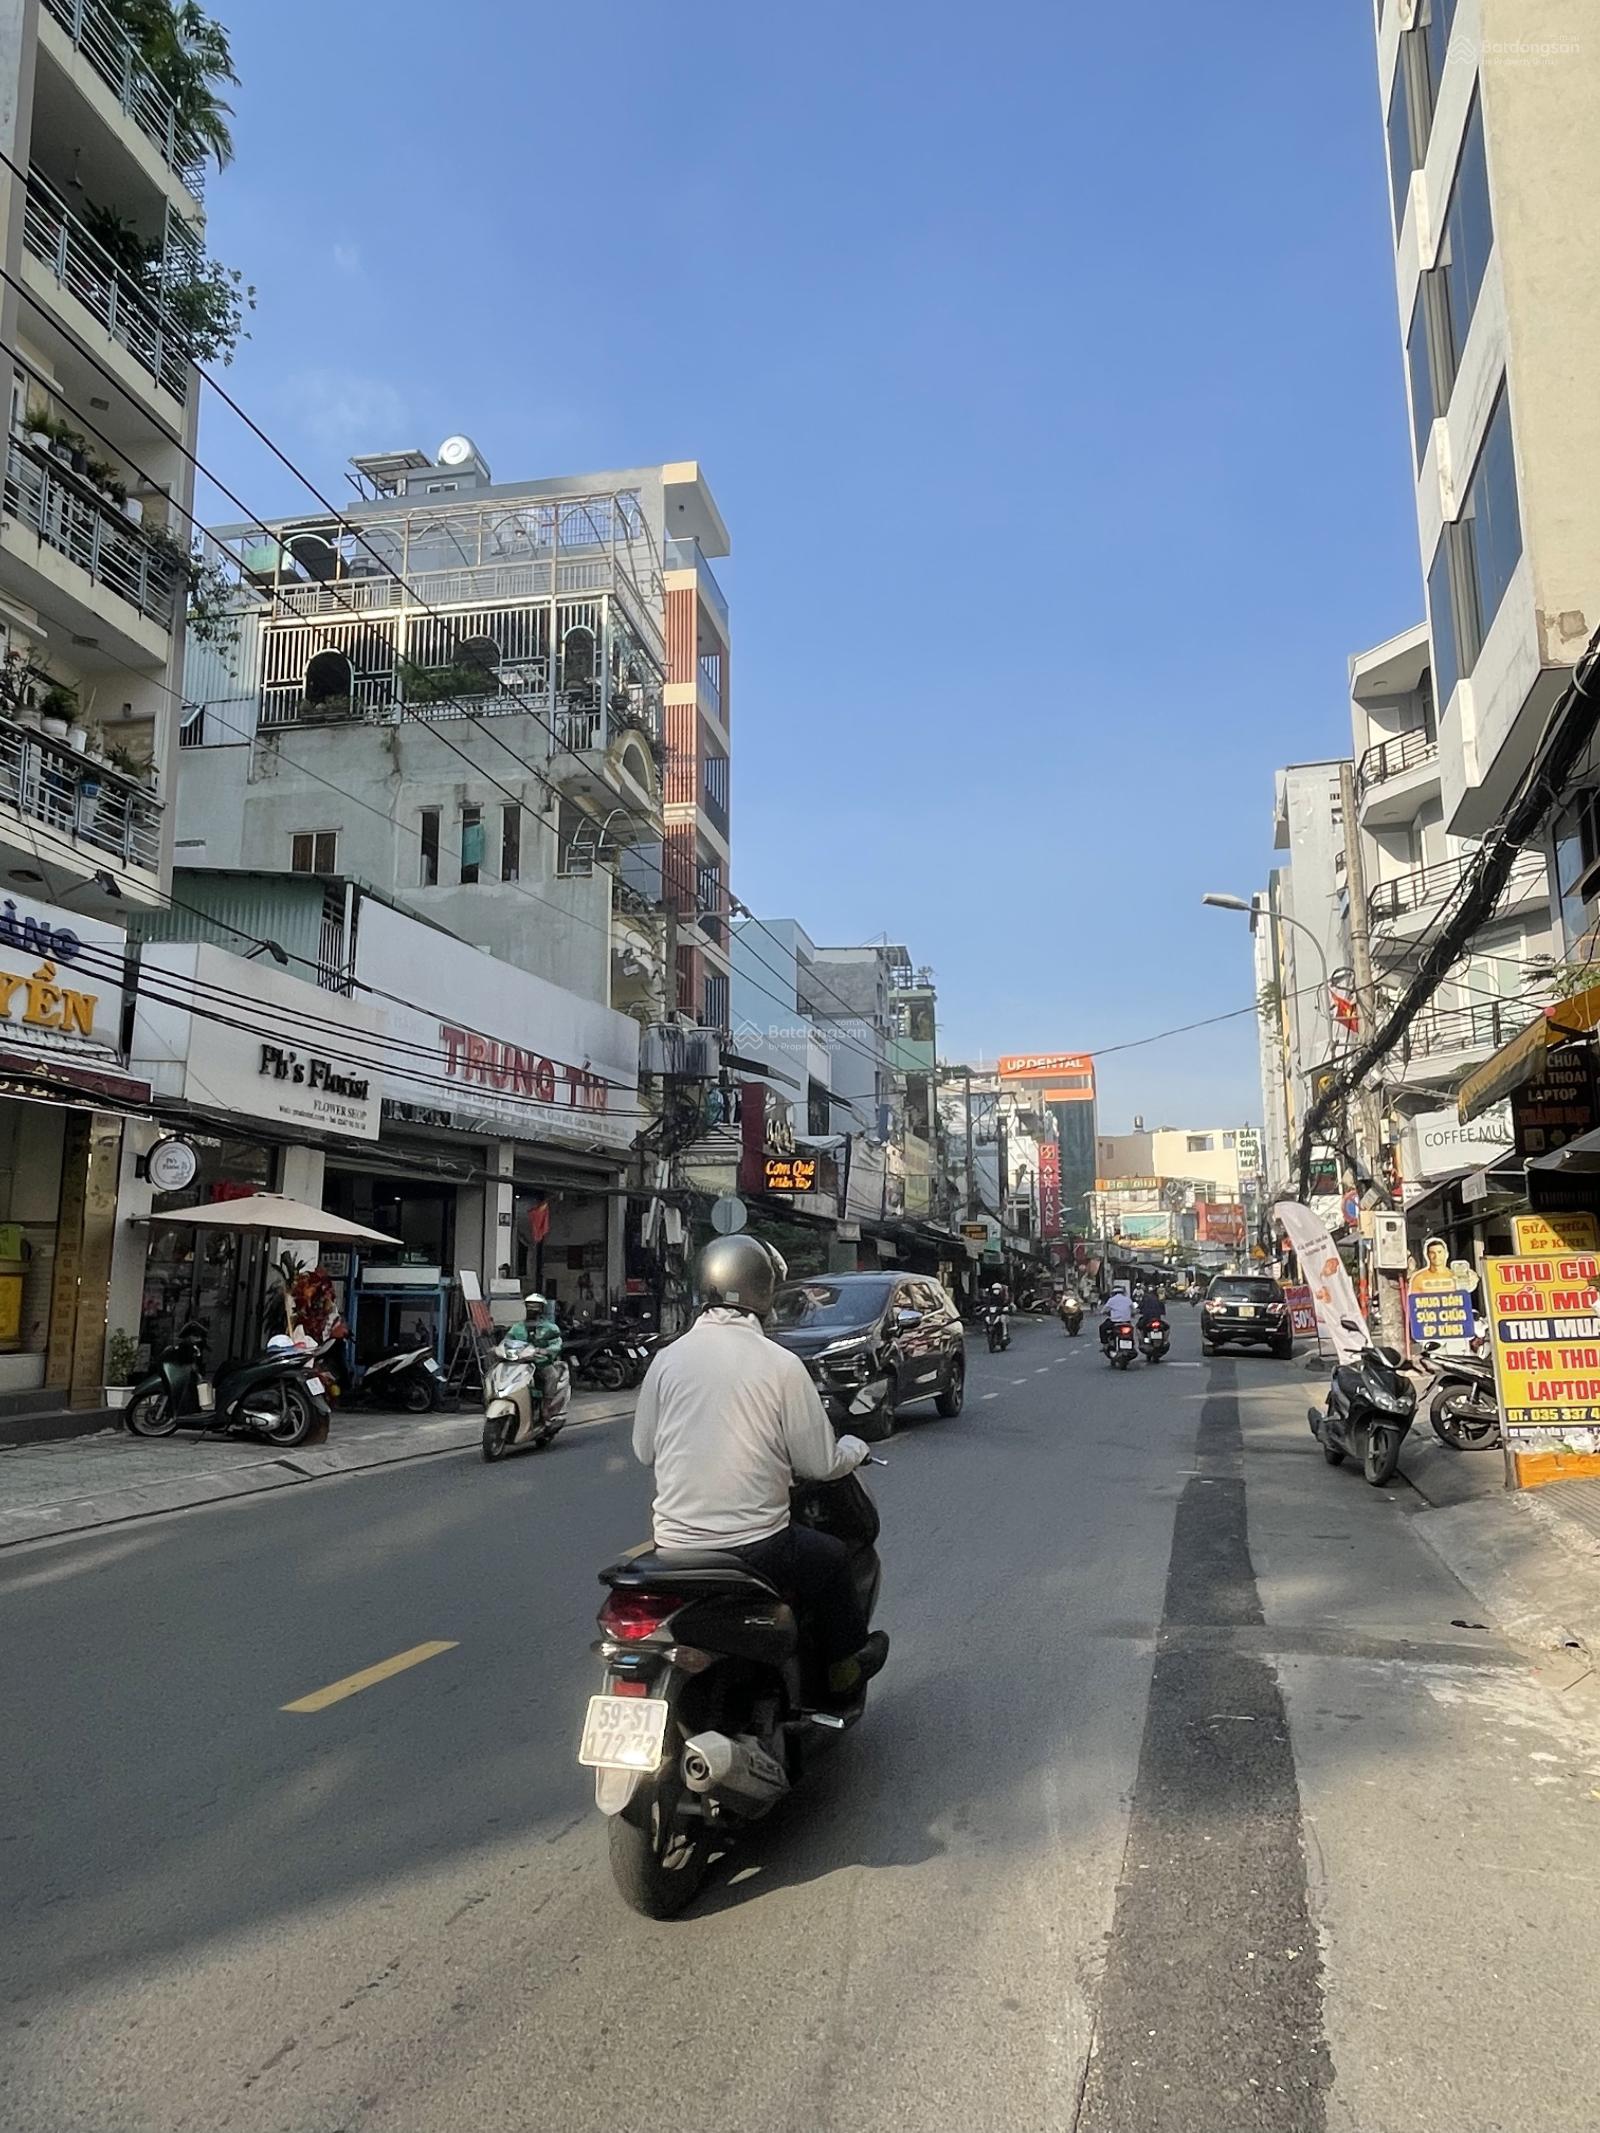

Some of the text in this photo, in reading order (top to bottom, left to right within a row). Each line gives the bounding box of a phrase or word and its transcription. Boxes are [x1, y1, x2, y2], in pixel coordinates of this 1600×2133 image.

[260, 1044, 370, 1101] Ph's Florist
[440, 1023, 555, 1102] TRUNG
[1528, 1087, 1577, 1103] LAPTOP
[313, 1099, 346, 1117] FLOWER
[1424, 1128, 1475, 1148] COFFEE
[793, 1159, 815, 1178] Quê
[1499, 1262, 1551, 1283] THU
[1293, 1309, 1315, 1329] 50%
[1506, 1320, 1550, 1340] THU
[1506, 1347, 1553, 1375] ĐIỆN
[1527, 1380, 1600, 1401] LAPTOP
[1530, 1408, 1559, 1420] 035
[1561, 1408, 1588, 1420] 337
